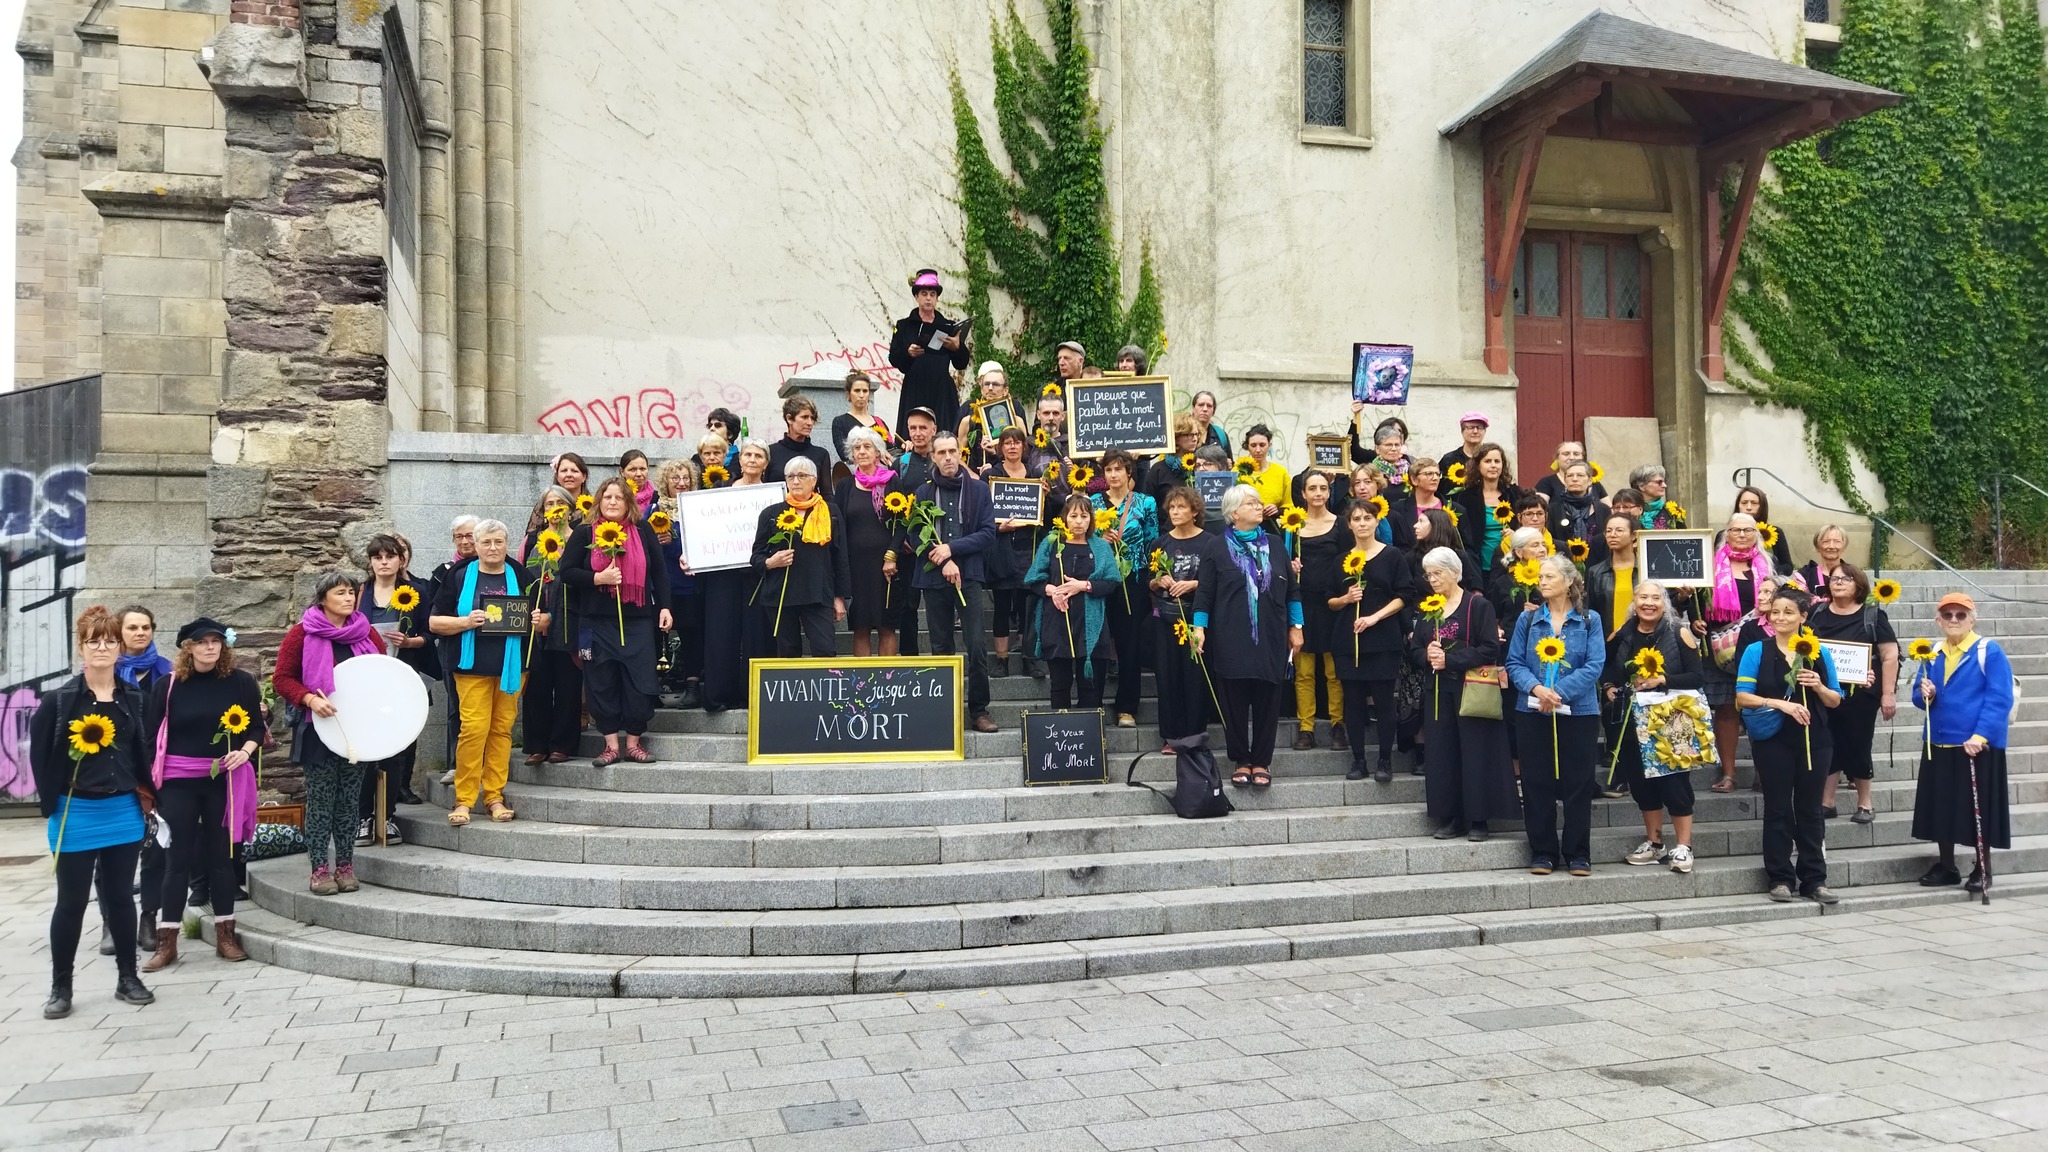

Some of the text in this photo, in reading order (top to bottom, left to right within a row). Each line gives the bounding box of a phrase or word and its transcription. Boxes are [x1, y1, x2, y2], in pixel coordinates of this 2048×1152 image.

[1078, 390, 1147, 404] La preuve que
[1078, 402, 1154, 422] parler de la mort
[1078, 422, 1091, 436] ça
[1092, 420, 1112, 435] peut
[1114, 418, 1132, 430] être
[1672, 558, 1701, 571] MORT
[506, 602, 528, 614] POUR
[509, 616, 525, 627] TOI
[764, 678, 943, 706] VIVANTE jusqu'à la
[815, 713, 909, 740] MORT
[1045, 724, 1058, 739] Je
[1042, 752, 1059, 771] Ma
